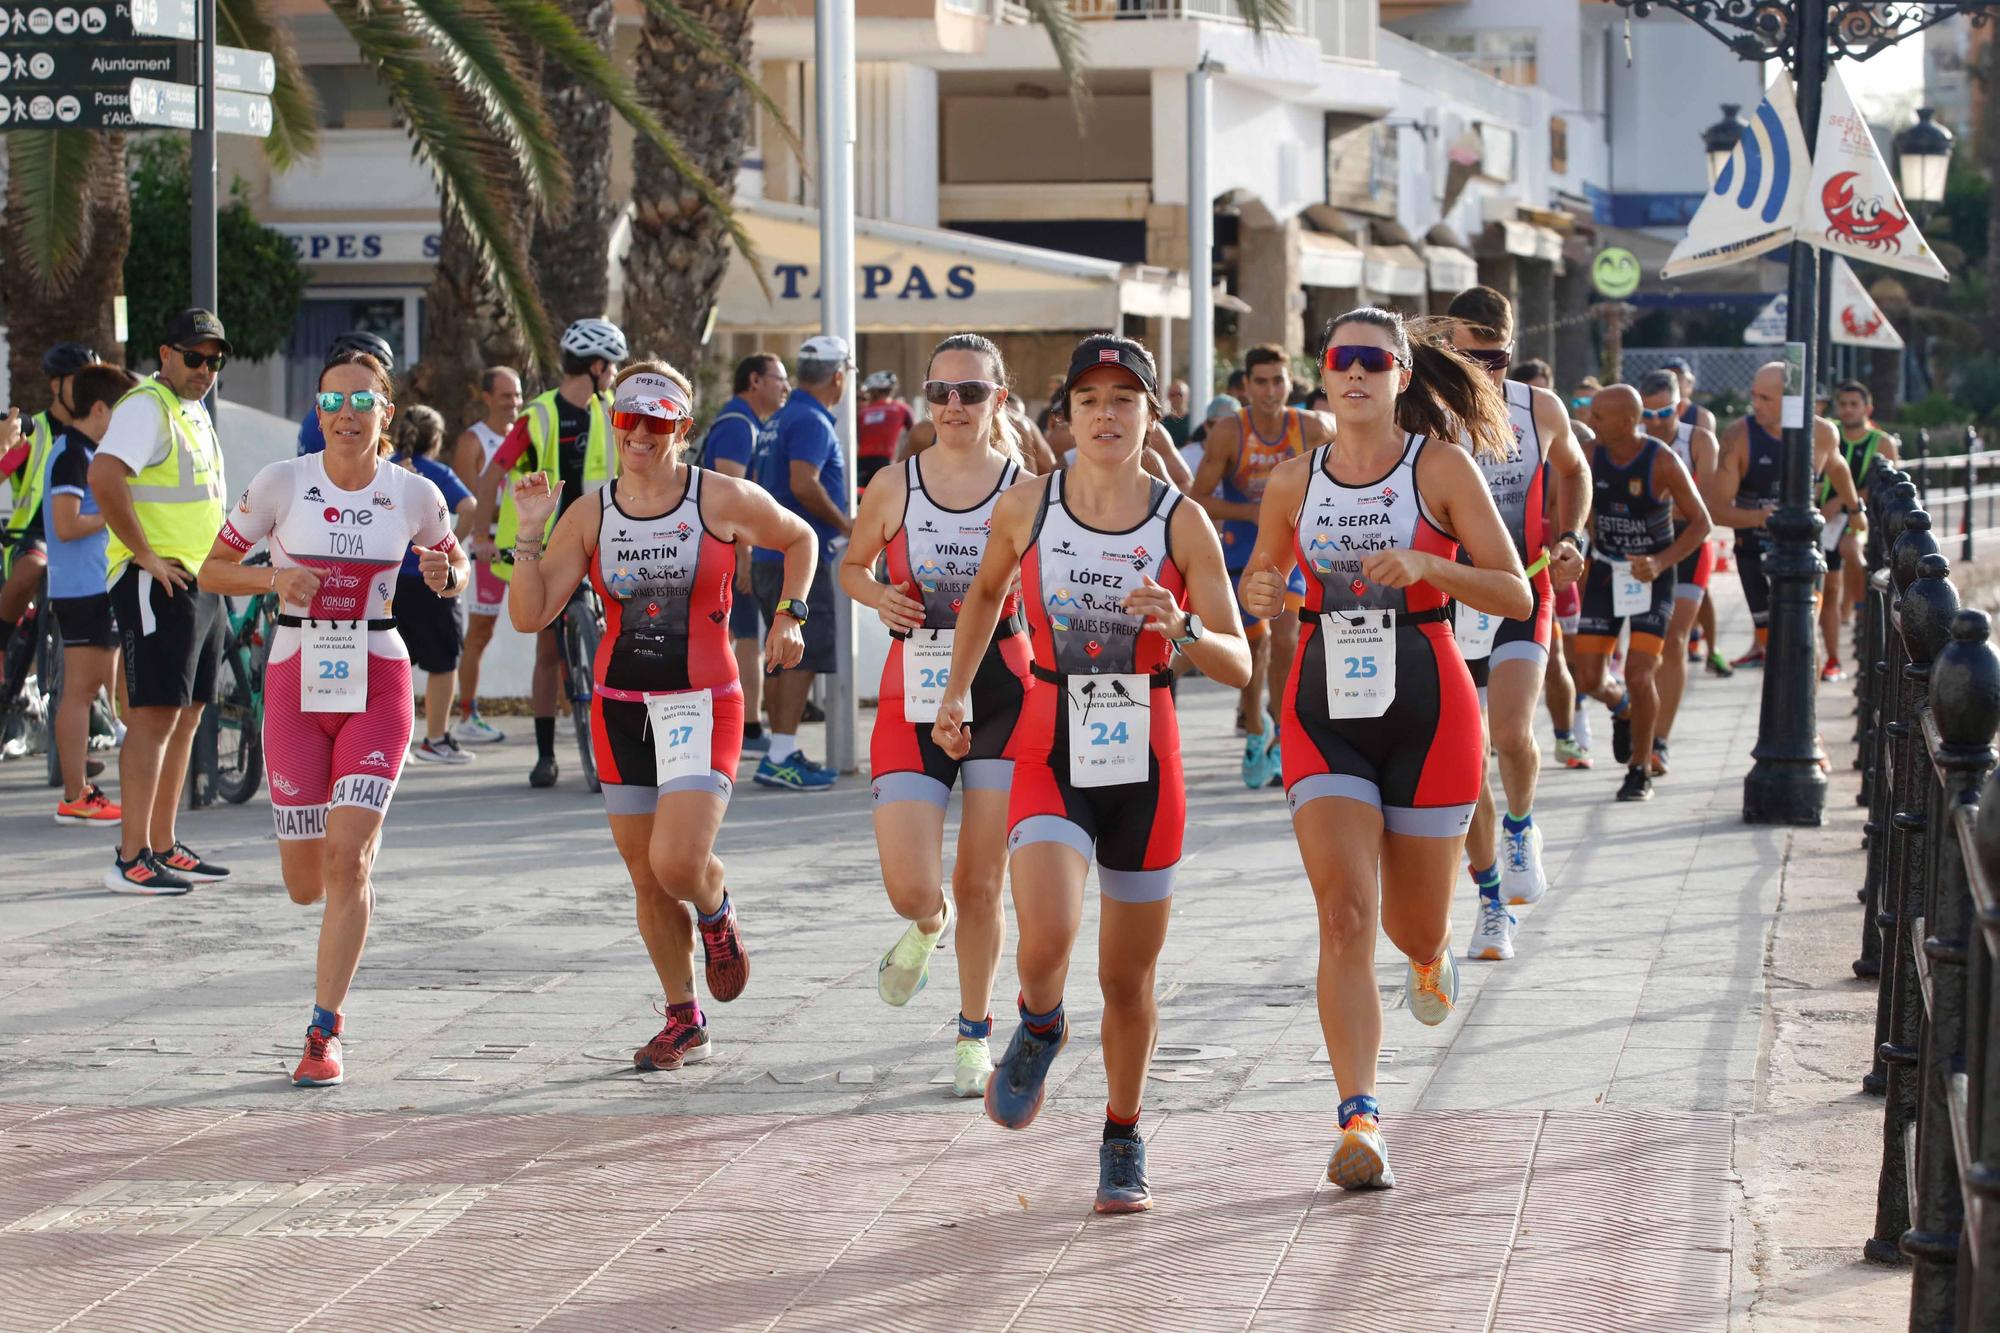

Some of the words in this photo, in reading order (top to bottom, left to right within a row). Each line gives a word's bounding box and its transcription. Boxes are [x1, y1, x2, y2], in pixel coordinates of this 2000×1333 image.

[91, 57, 171, 73] Ajuntament
[773, 264, 977, 300] TPAS
[1316, 515, 1334, 528] M.
[1337, 512, 1392, 528] SERRA
[1598, 515, 1647, 534] ESTEBAN
[328, 532, 365, 557] TOYA
[617, 543, 678, 562] MARTÍN
[935, 542, 979, 557] VIÑAS
[1340, 535, 1400, 552] Puchet
[637, 567, 689, 581] Puchet
[1069, 567, 1124, 590] LÓPEZ
[1625, 583, 1642, 595] 23
[321, 595, 357, 609] YOKUBO
[1081, 593, 1129, 616] Puche
[1069, 617, 1099, 633] VIAJES
[1099, 619, 1111, 634] ES
[1111, 621, 1139, 637] FREUS
[319, 660, 350, 679] 28
[1343, 655, 1378, 679] 25
[920, 668, 949, 688] 26
[668, 726, 694, 748] 27
[1090, 720, 1129, 746] 24
[350, 778, 392, 810] HALF
